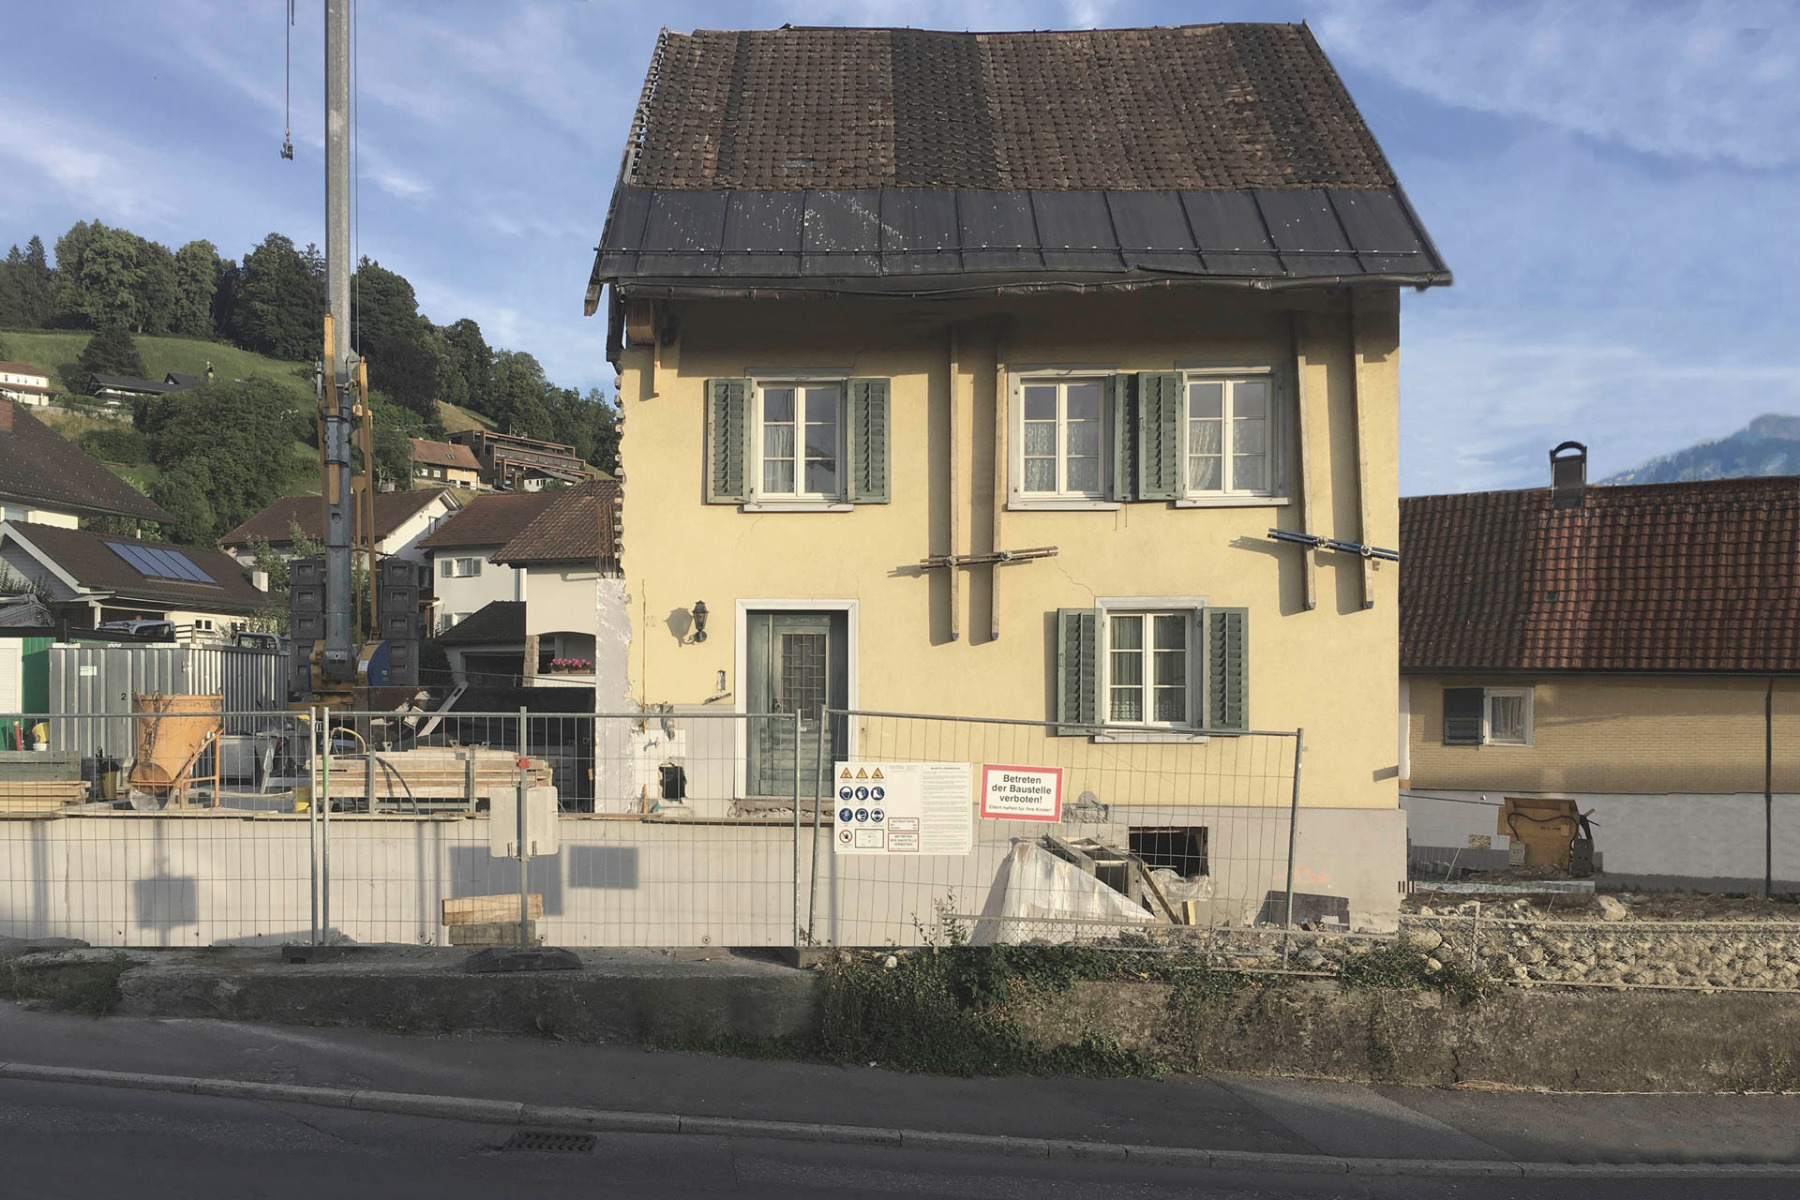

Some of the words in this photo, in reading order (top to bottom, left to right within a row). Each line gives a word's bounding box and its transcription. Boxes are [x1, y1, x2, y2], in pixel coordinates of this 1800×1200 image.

[121, 692, 126, 700] 2
[1003, 774, 1041, 784] Betreten
[991, 784, 1007, 792] der
[1010, 784, 1052, 794] Baustelle
[1000, 795, 1042, 803] verboten!
